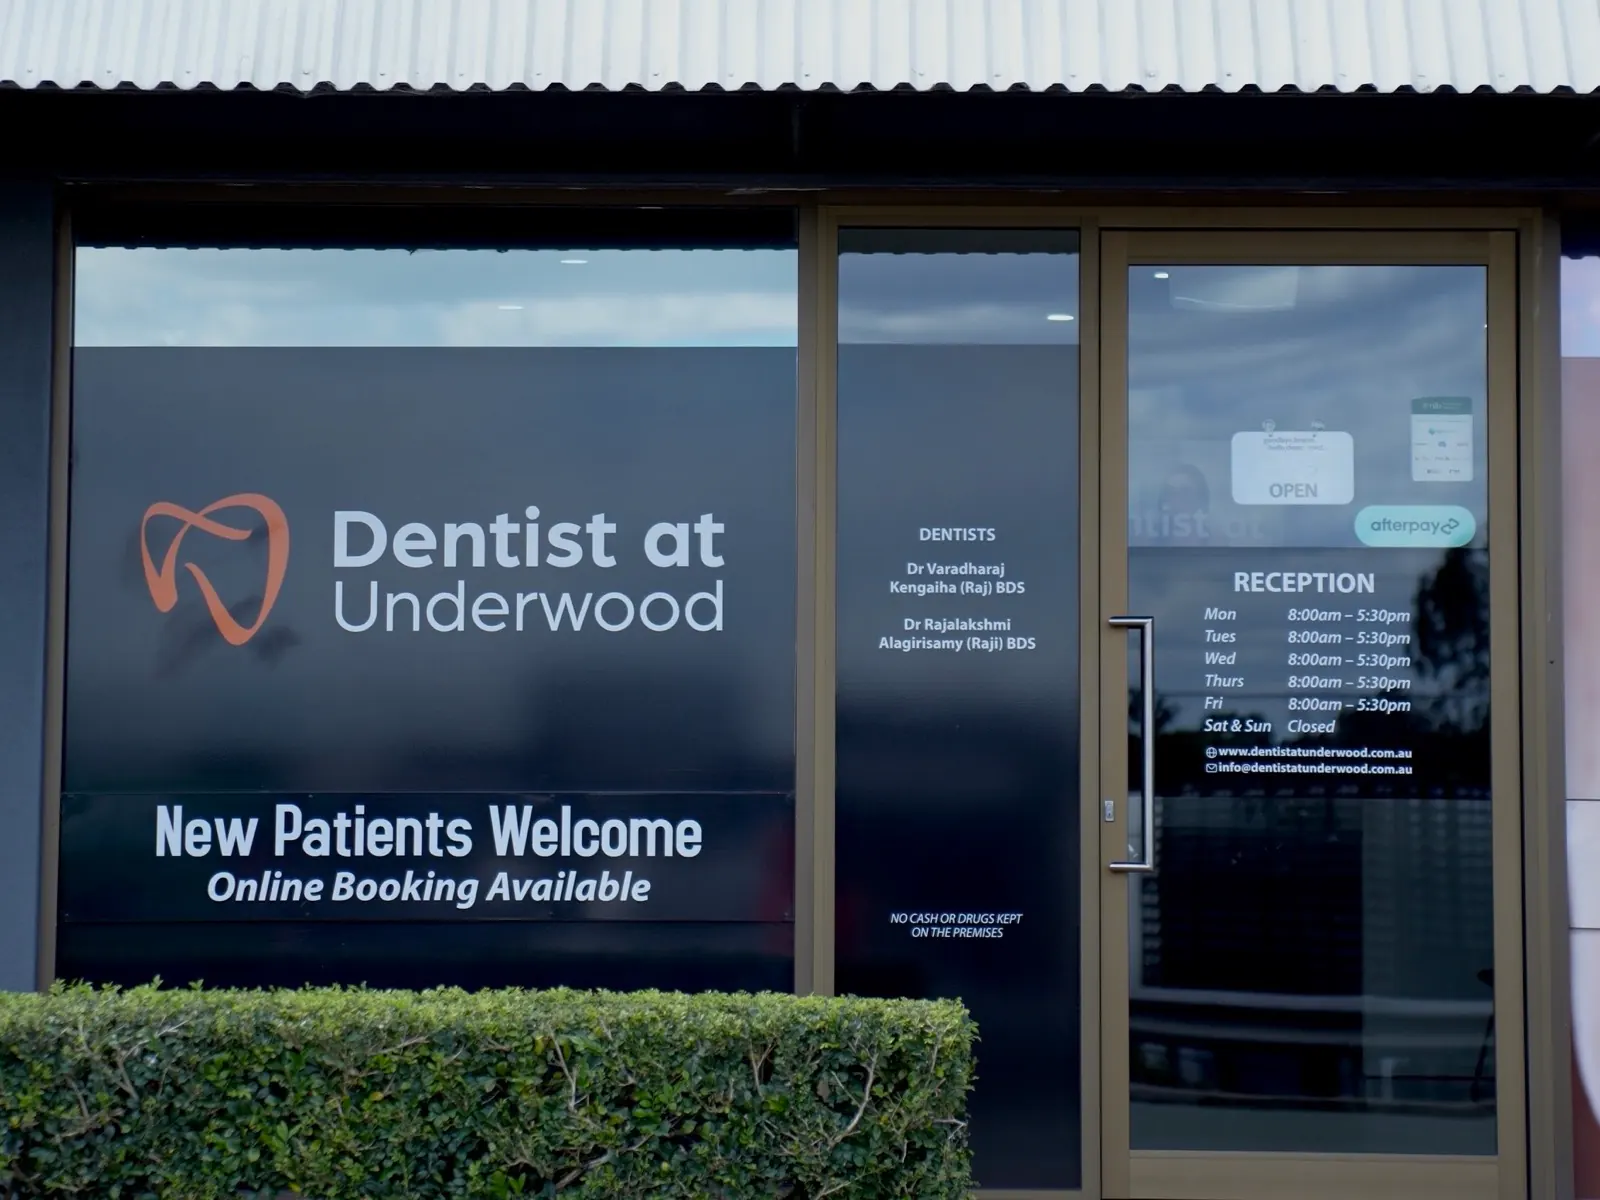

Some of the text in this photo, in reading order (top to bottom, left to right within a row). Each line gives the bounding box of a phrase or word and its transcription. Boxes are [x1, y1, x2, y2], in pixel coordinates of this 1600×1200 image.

[1269, 482, 1318, 498] OPEN
[919, 527, 996, 542] DENTISTS
[1370, 517, 1440, 536] afterpay
[334, 505, 726, 568] Dentist at
[907, 562, 1005, 578] Dr Varadharaj
[890, 580, 1025, 597] Kengaiha (Raj) BDS
[1234, 571, 1376, 594] RECEPTION
[334, 579, 724, 633] Underwood
[1203, 607, 1237, 621] Mon
[1287, 608, 1342, 622] 8:00am
[1356, 608, 1411, 626] 5:30pm
[904, 618, 1011, 634] Dr Rajalakshmi
[878, 636, 1036, 652] Alagirisamy (Raji) BDS
[1204, 629, 1237, 643] Tues
[1287, 630, 1342, 644] 8:00am
[1356, 631, 1411, 648] 5:30pm
[1204, 651, 1237, 665] Wed
[1288, 653, 1342, 667] 8:00am
[1356, 653, 1411, 670] 5:30pm
[1204, 674, 1245, 688] Thurs
[1288, 675, 1342, 689] 8:00am
[1356, 676, 1411, 693] 5:30pm
[1204, 696, 1224, 710] Fri
[1288, 697, 1342, 711] 8:00am
[1357, 698, 1412, 715] 5:30pm
[1203, 718, 1336, 734] Sat & Sun Closed
[1218, 746, 1413, 759] www.dentistatunderwood.com.au
[1218, 761, 1413, 775] info@dentistatunderwood.com.au
[155, 803, 703, 858] New Patients Welcome
[206, 870, 652, 910] Online Booking Available
[890, 913, 1024, 925] NO CASH OR DRUGS KEPT
[911, 927, 1004, 938] ON THE PREMISES
